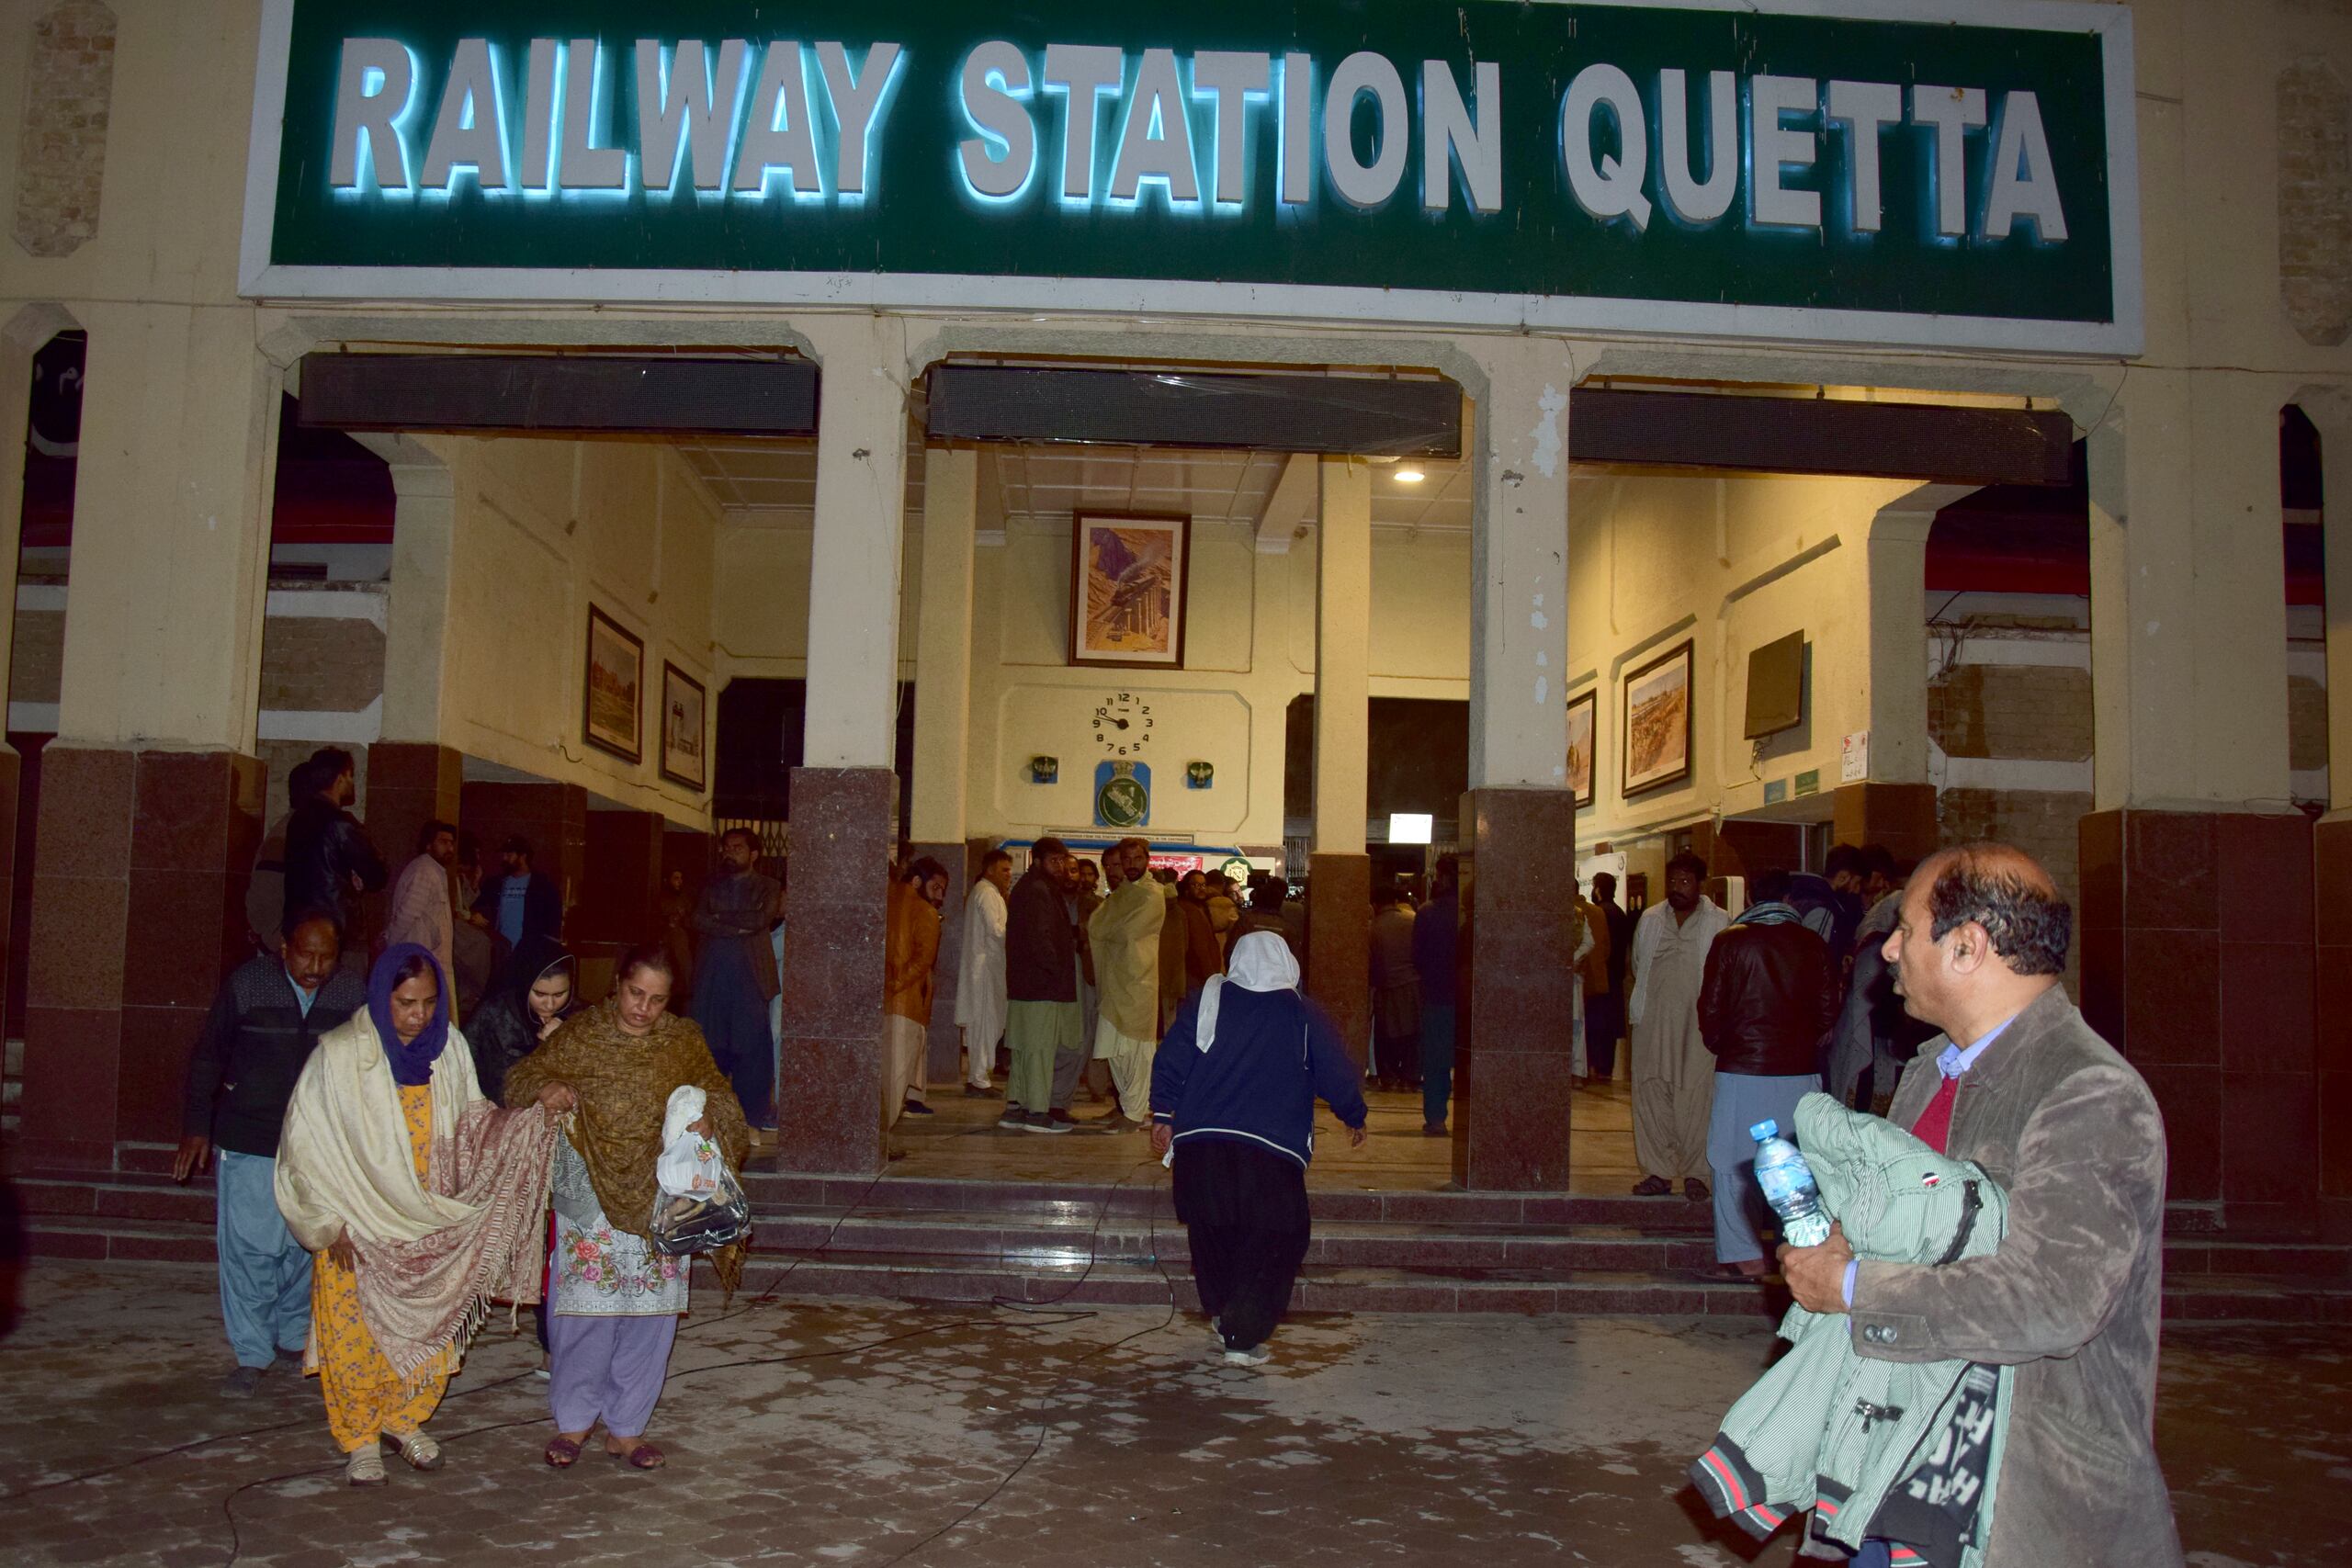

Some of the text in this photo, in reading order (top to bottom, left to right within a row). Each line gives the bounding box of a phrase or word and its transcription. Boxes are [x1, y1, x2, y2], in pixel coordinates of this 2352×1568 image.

[329, 38, 2069, 243] RAILWAY STATION QUETTA
[1106, 697, 1114, 705] 11
[1118, 694, 1130, 702] 12
[1136, 696, 1140, 705] 1
[1095, 707, 1107, 716] 10
[1141, 706, 1150, 715] 2
[1092, 719, 1101, 728] 9
[1146, 718, 1153, 728] 3
[1096, 734, 1104, 742] 8
[1142, 734, 1149, 742] 4
[1106, 743, 1114, 751] 7
[1118, 746, 1126, 755] 6
[1133, 742, 1140, 751] 5
